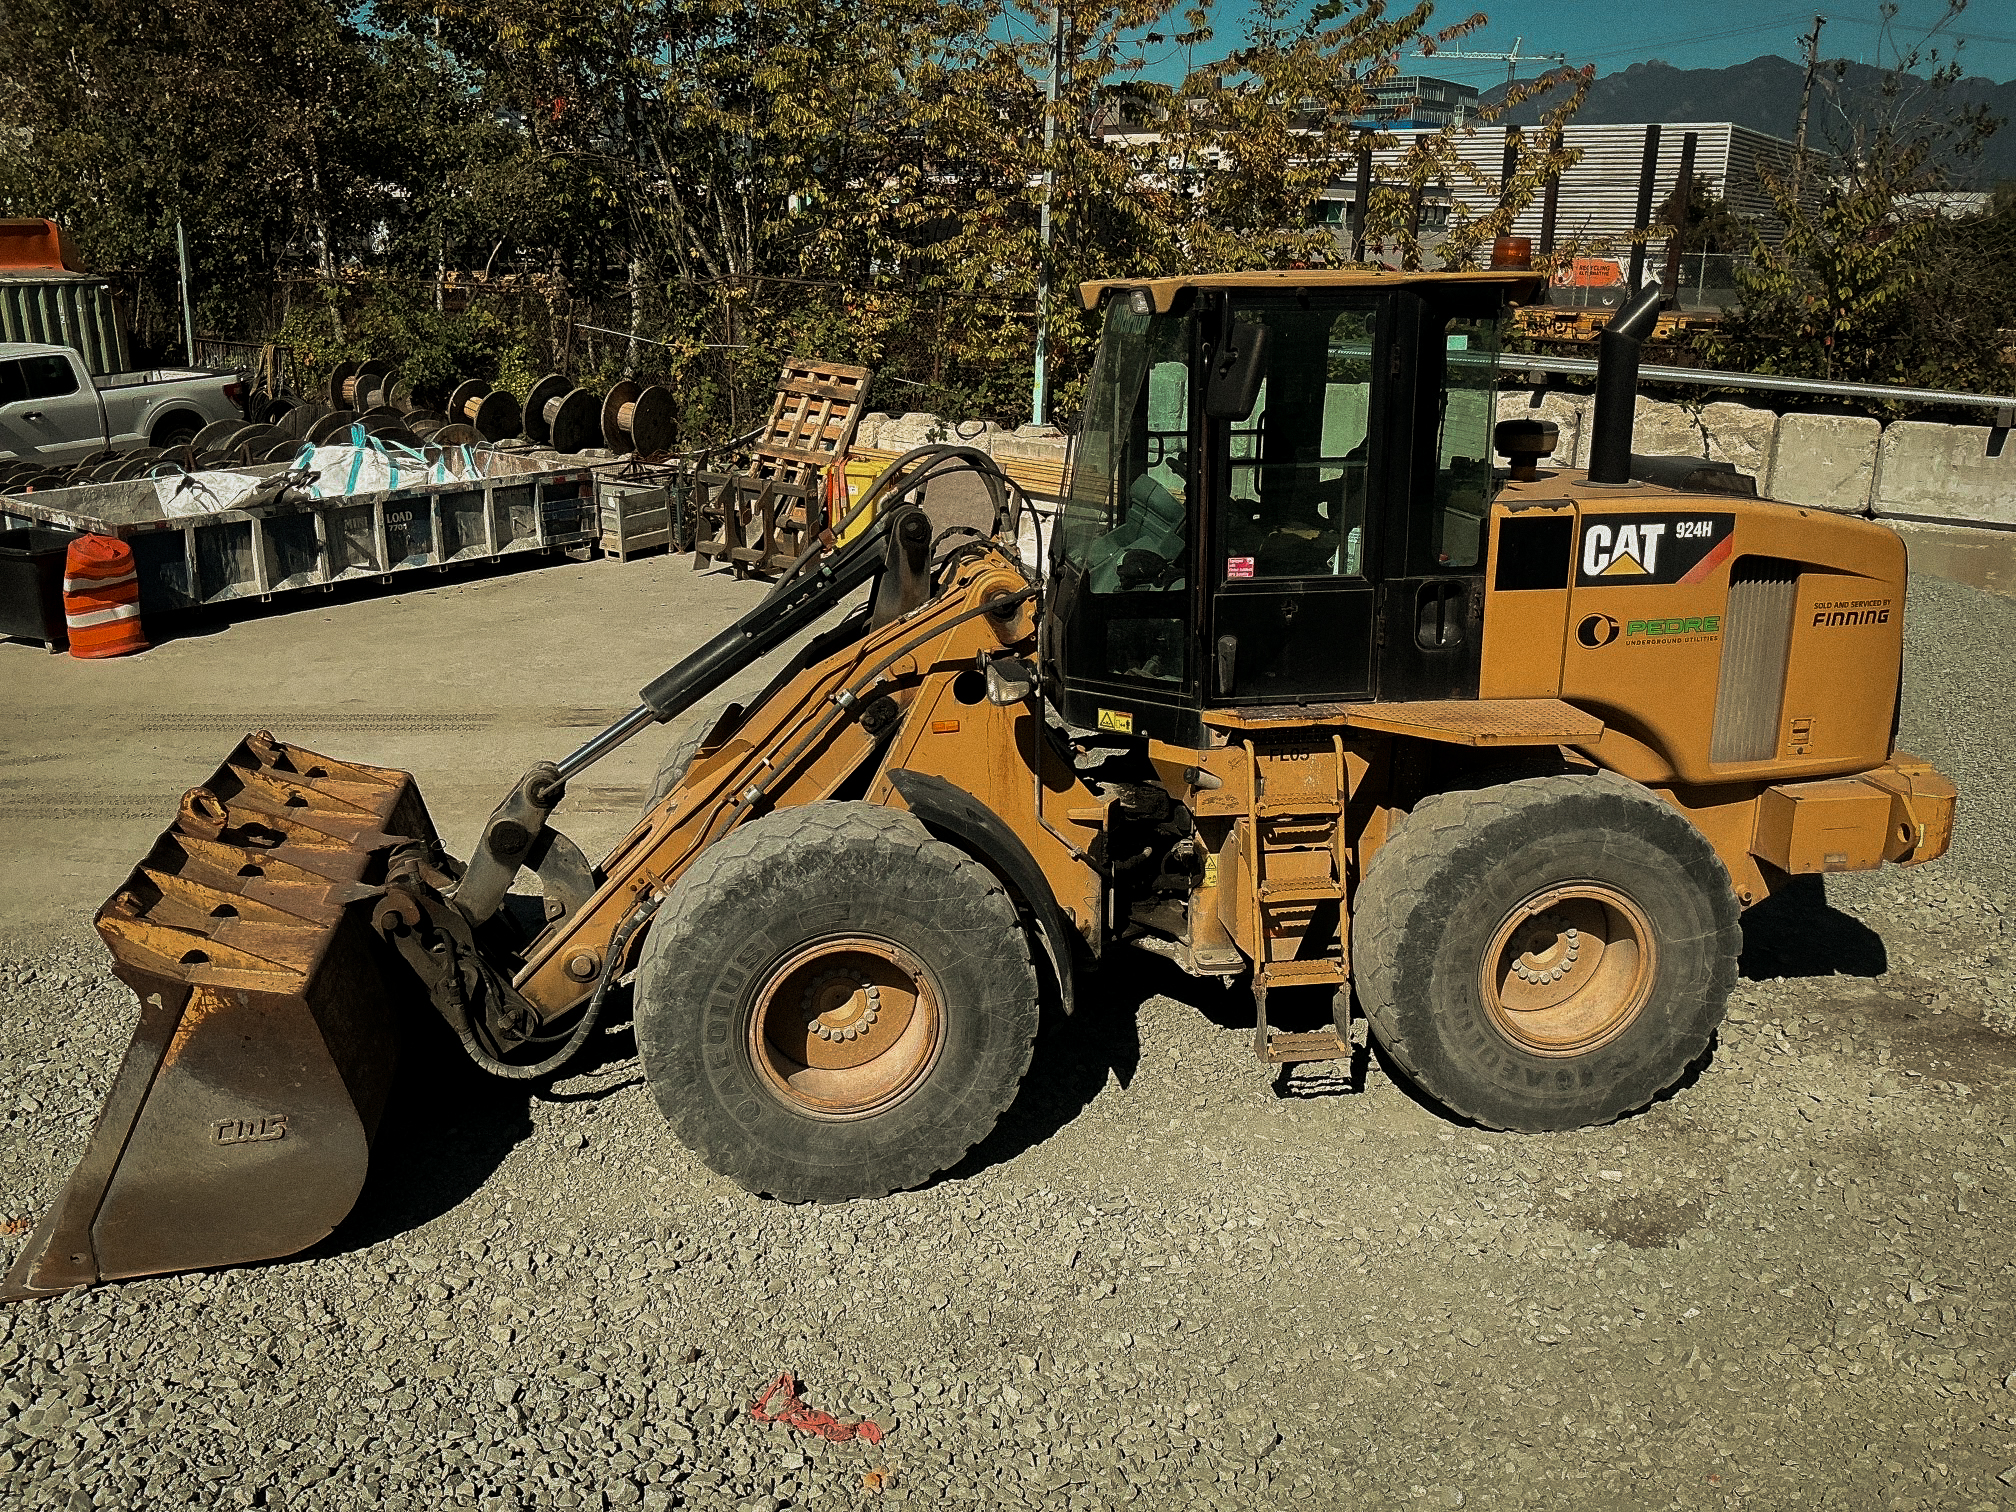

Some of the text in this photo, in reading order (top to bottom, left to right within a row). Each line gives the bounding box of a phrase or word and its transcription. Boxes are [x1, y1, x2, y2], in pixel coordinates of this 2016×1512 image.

[386, 511, 412, 524] LOAD
[1583, 520, 1713, 576] CAT 924H
[1814, 602, 1832, 610] SOLD
[1834, 601, 1849, 609] AND
[1851, 600, 1882, 608] SERVICED
[1626, 616, 1720, 636] PEDRE
[1812, 609, 1890, 627] FINNING
[1626, 635, 1719, 646] UNDERGROUND UTILITIES
[210, 1113, 288, 1147] CWS
